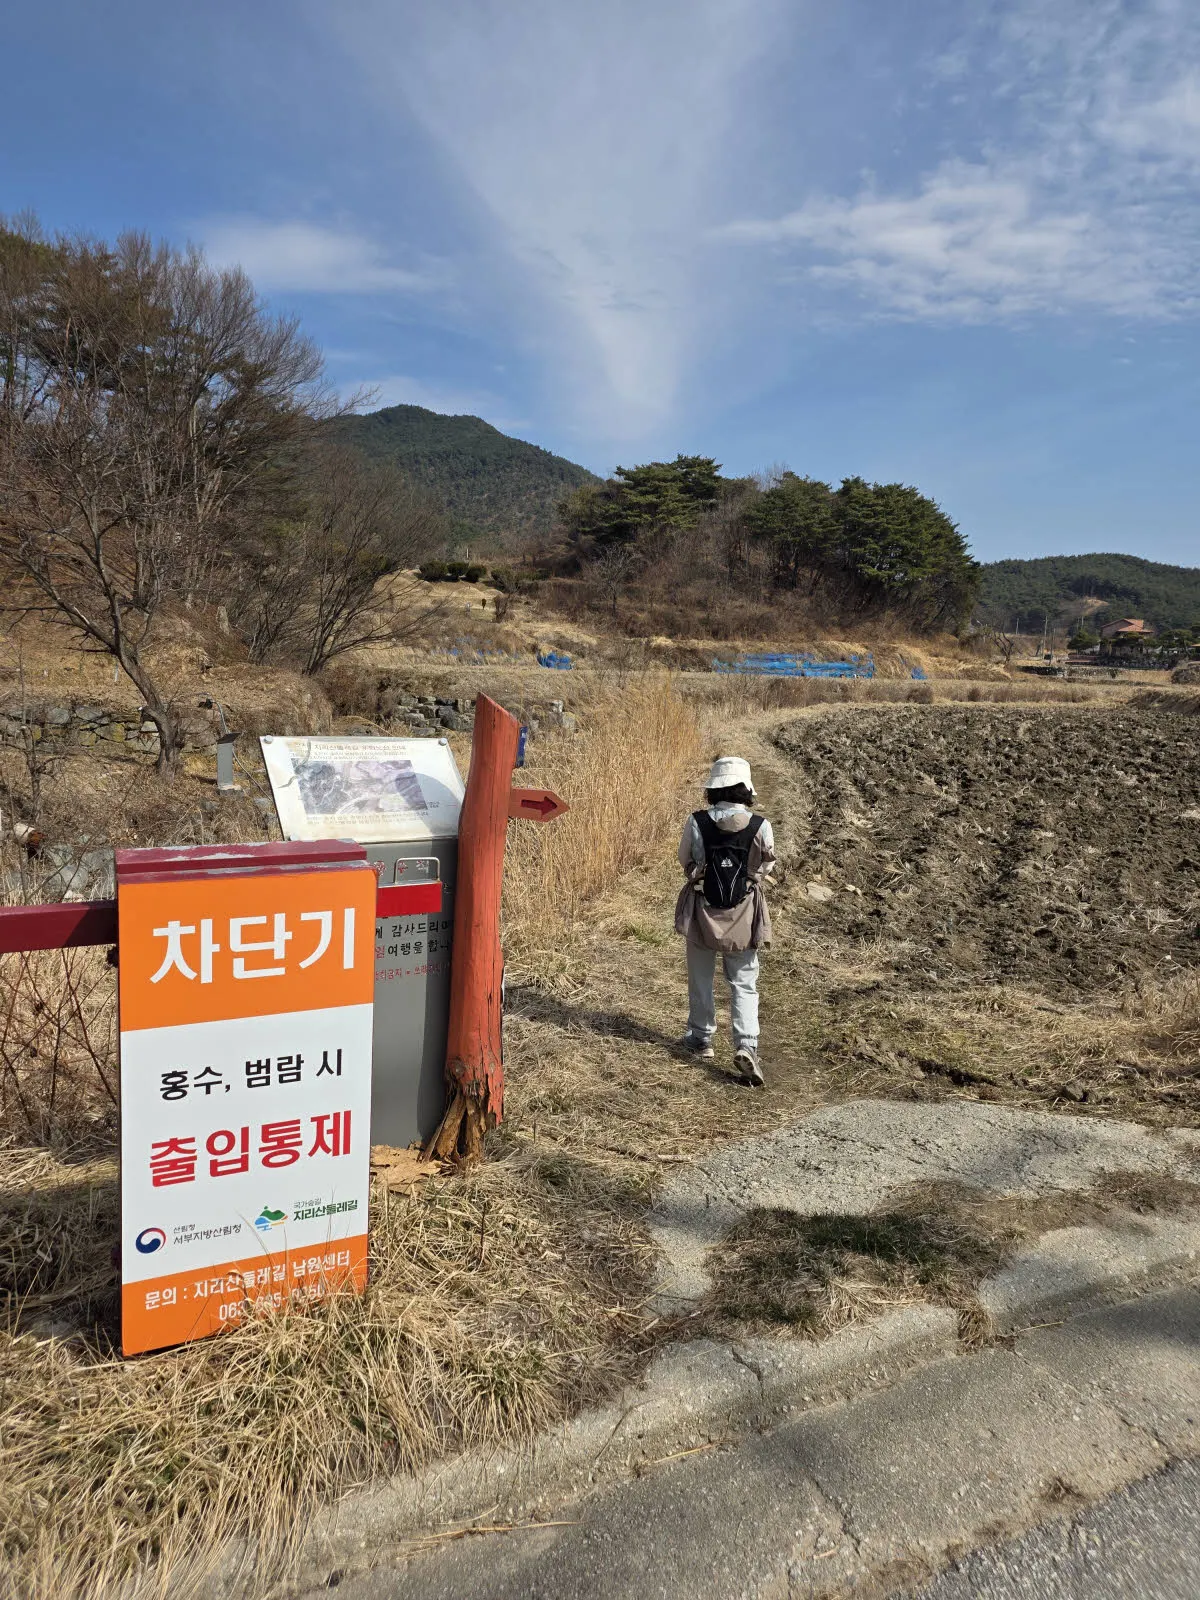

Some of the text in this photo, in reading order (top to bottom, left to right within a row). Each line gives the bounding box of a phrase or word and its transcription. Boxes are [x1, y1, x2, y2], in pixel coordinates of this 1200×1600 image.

[149, 907, 356, 985] 차단기
[160, 1048, 342, 1101] 홍수, 범람 시
[149, 1109, 352, 1188] 출입통제
[293, 1197, 322, 1209] 국가숲길
[293, 1199, 358, 1221] 지리산둘레길
[173, 1223, 196, 1234] 산림청
[173, 1223, 242, 1245] 서부지방산림청
[144, 1286, 177, 1310] 문의
[193, 1263, 286, 1300] 지리산둘레길
[293, 1250, 350, 1277] 남원센터
